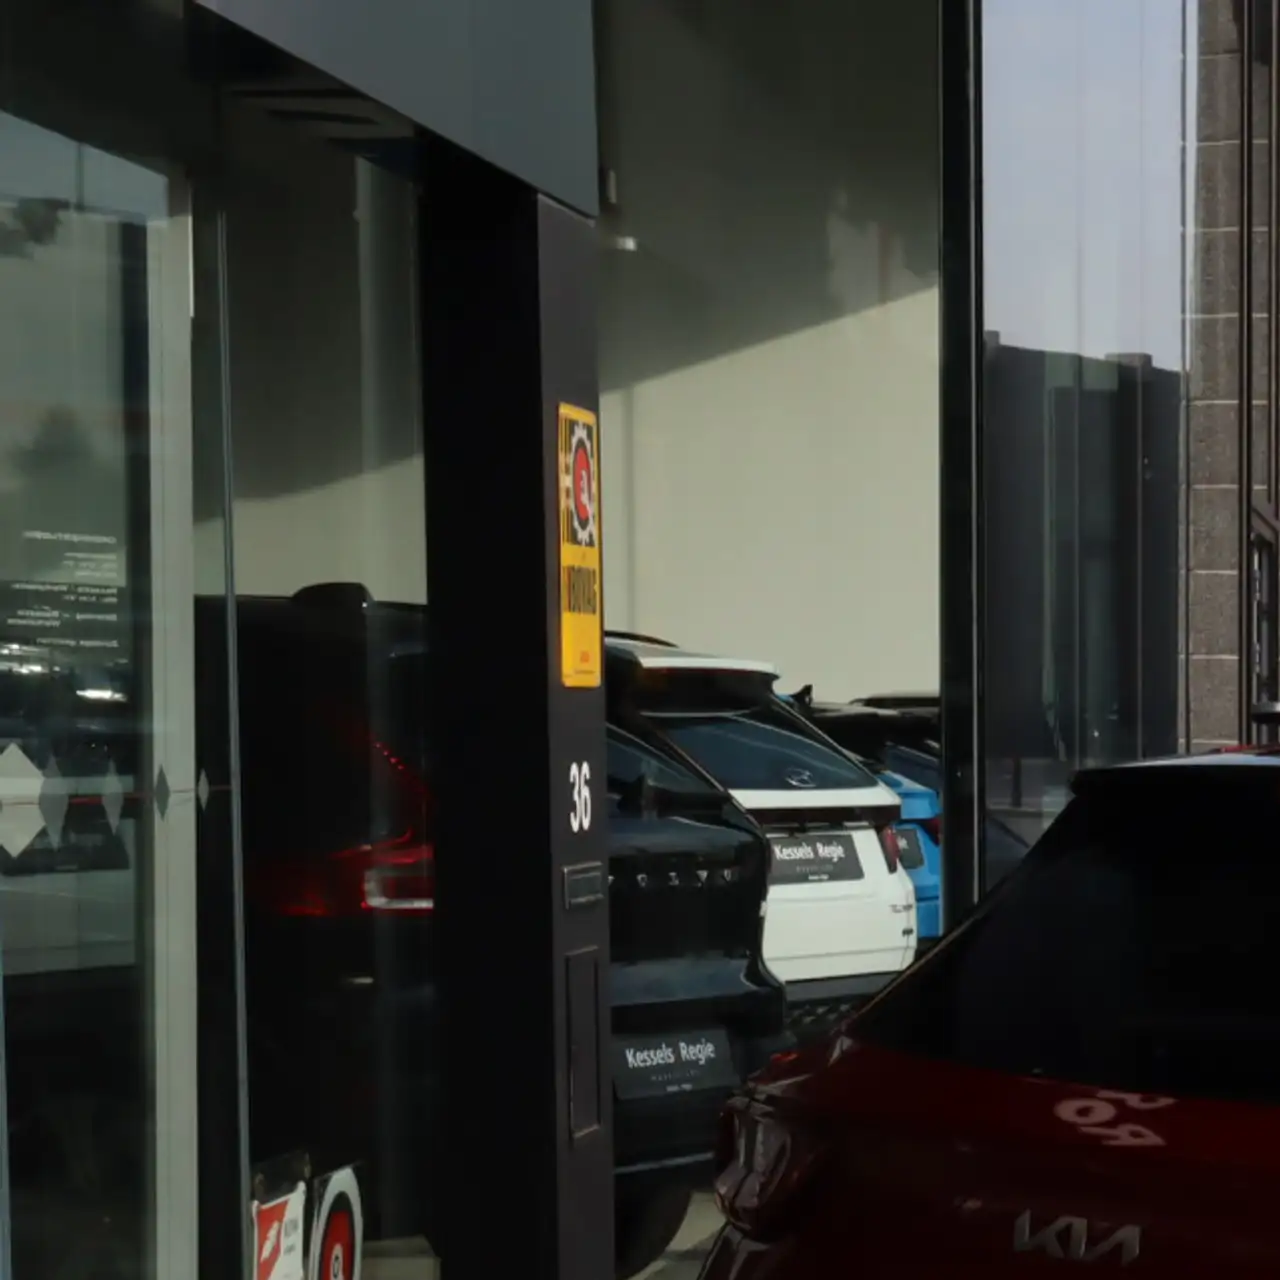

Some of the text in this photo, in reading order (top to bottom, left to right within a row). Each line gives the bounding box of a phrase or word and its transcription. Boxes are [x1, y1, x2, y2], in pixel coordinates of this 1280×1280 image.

[569, 760, 592, 833] 36
[773, 840, 845, 863] Kessels Regie
[625, 1037, 716, 1069] Kessels Regie
[1013, 1208, 1141, 1267] KIA
